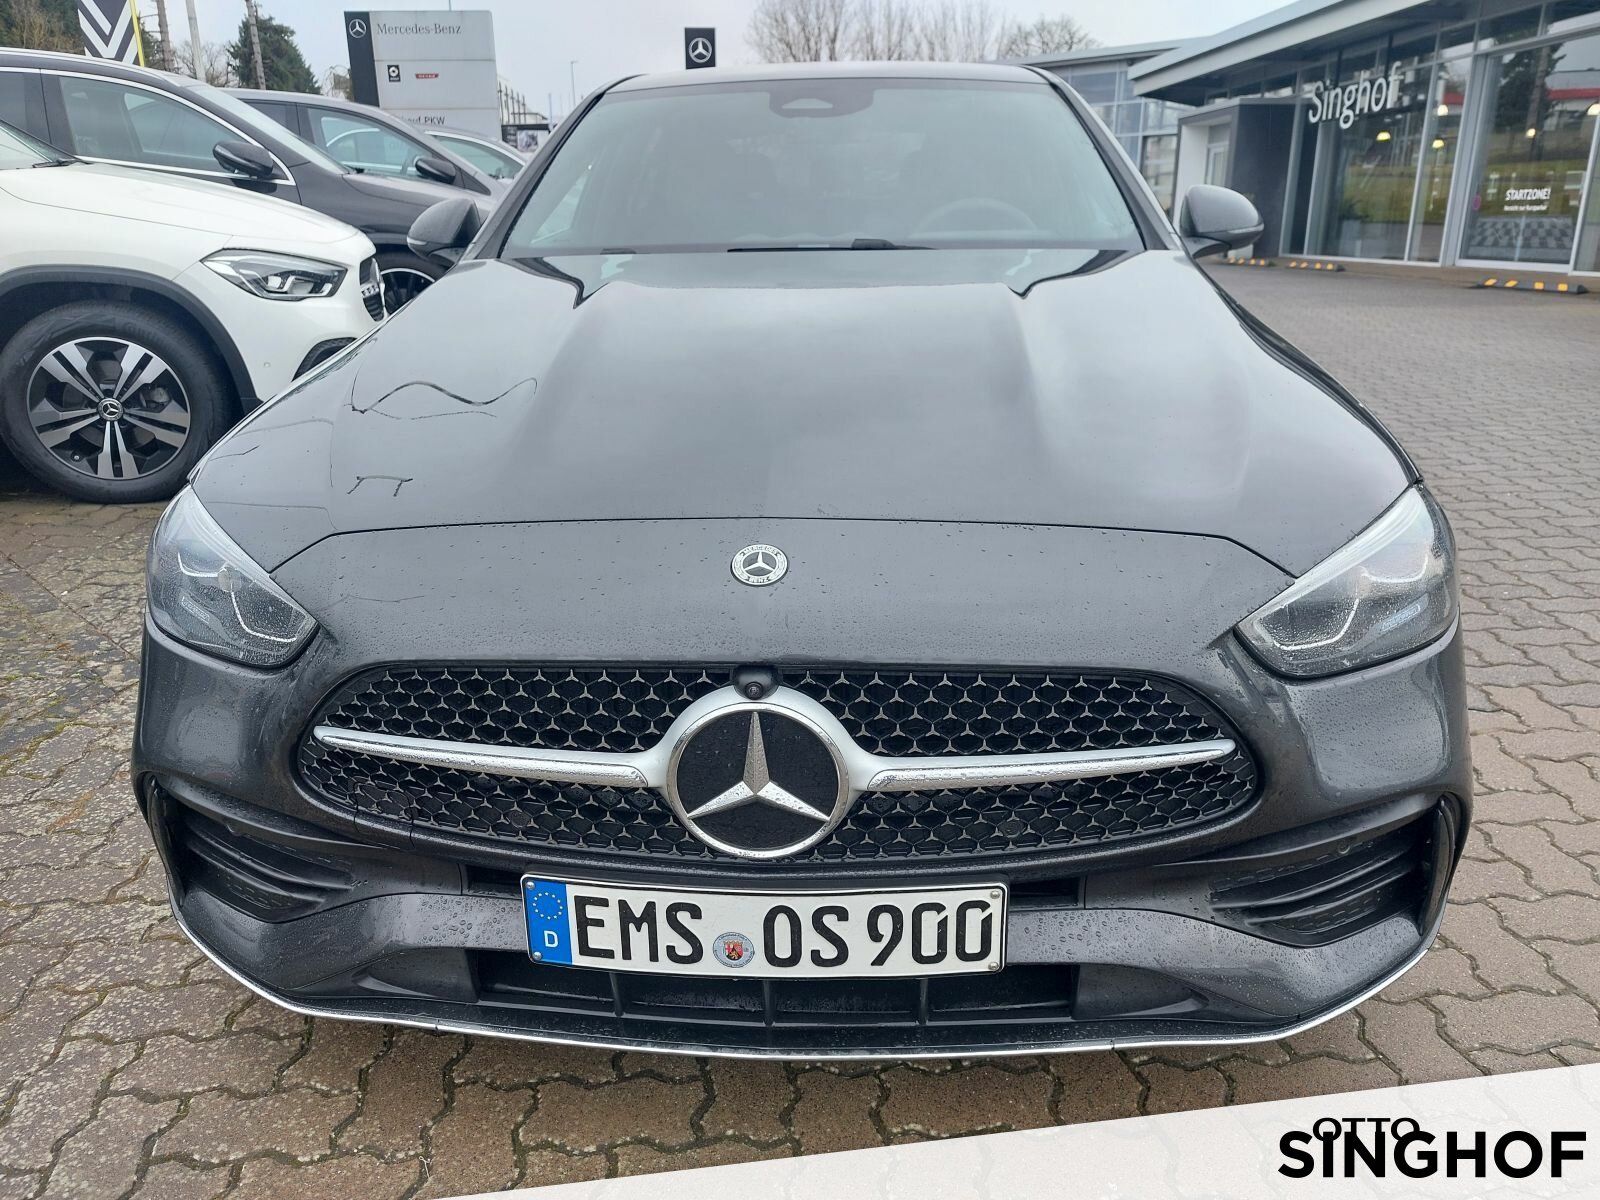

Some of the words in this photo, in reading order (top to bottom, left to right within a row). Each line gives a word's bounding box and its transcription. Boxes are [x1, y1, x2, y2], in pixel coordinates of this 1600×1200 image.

[377, 24, 462, 35] Mercedes-Benz
[1308, 61, 1404, 130] Singhof
[424, 116, 446, 125] PKW
[543, 930, 559, 948] D
[573, 894, 704, 966] EMS
[762, 904, 849, 968] OS
[866, 899, 994, 967] 900
